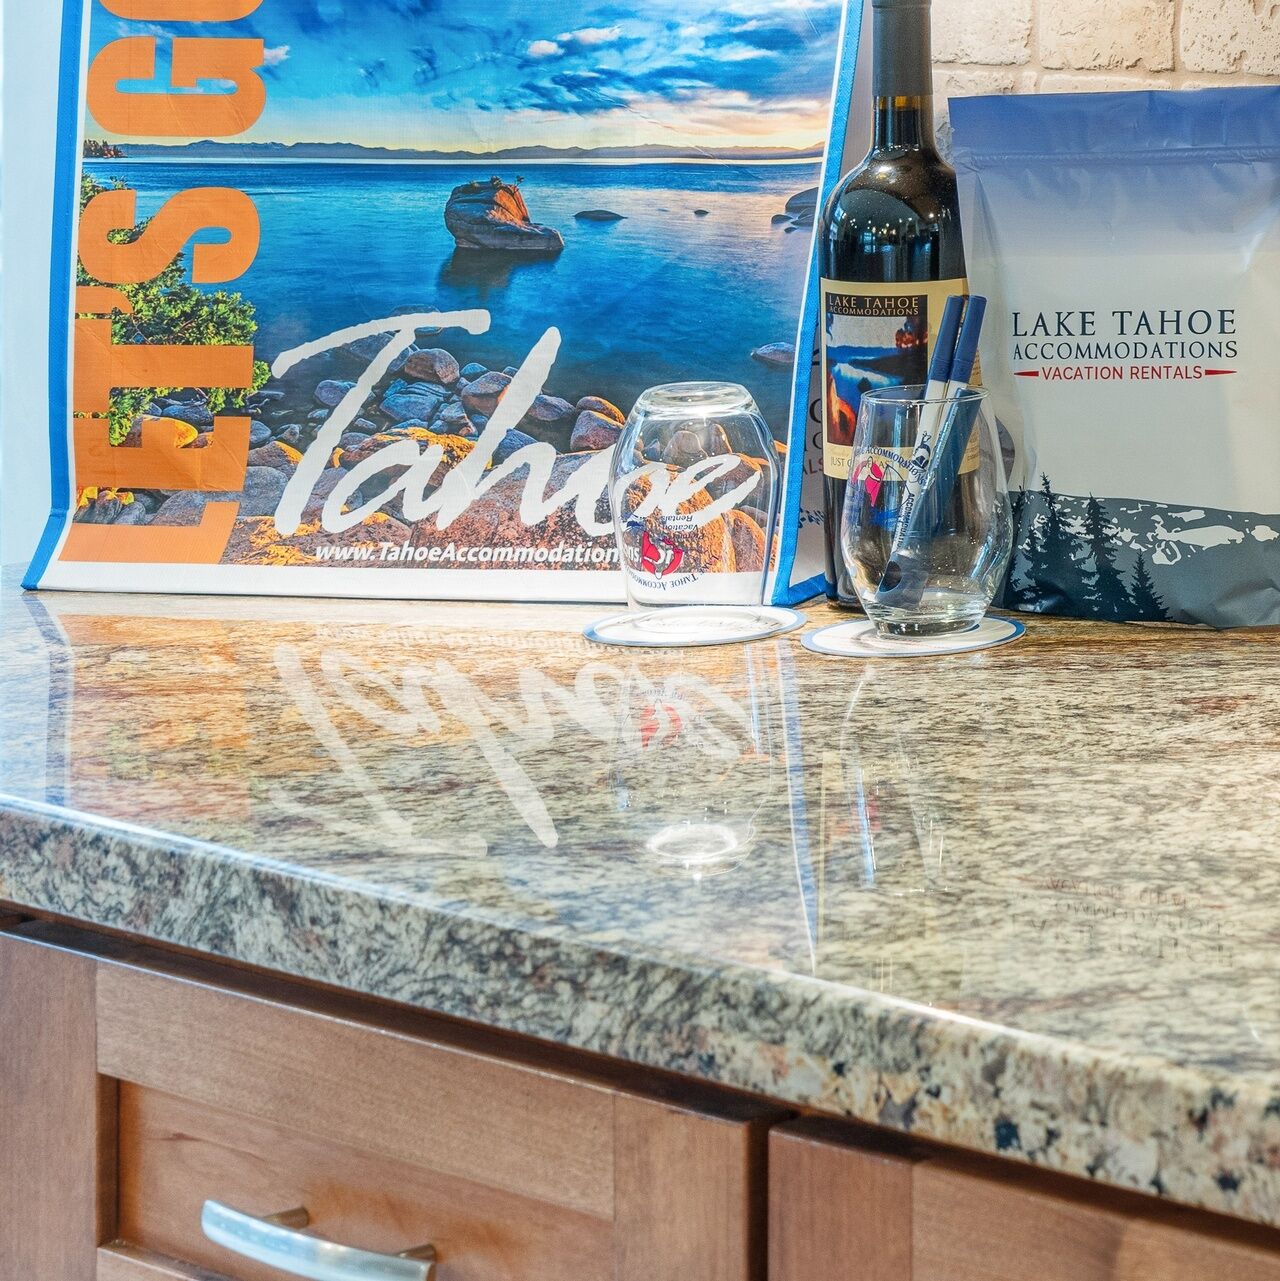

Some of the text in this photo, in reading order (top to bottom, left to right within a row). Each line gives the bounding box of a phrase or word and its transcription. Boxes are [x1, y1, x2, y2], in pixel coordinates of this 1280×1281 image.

[829, 296, 919, 308] LAKE TAHOE
[829, 307, 919, 317] ACCOMMODATIONS
[1012, 309, 1237, 337] LAKE TAHOE
[1013, 340, 1238, 360] ACCOMMODATIONS
[57, 186, 262, 563] LET'S
[1042, 365, 1203, 380] VACATION RENTALS
[271, 309, 763, 538] Tahoe
